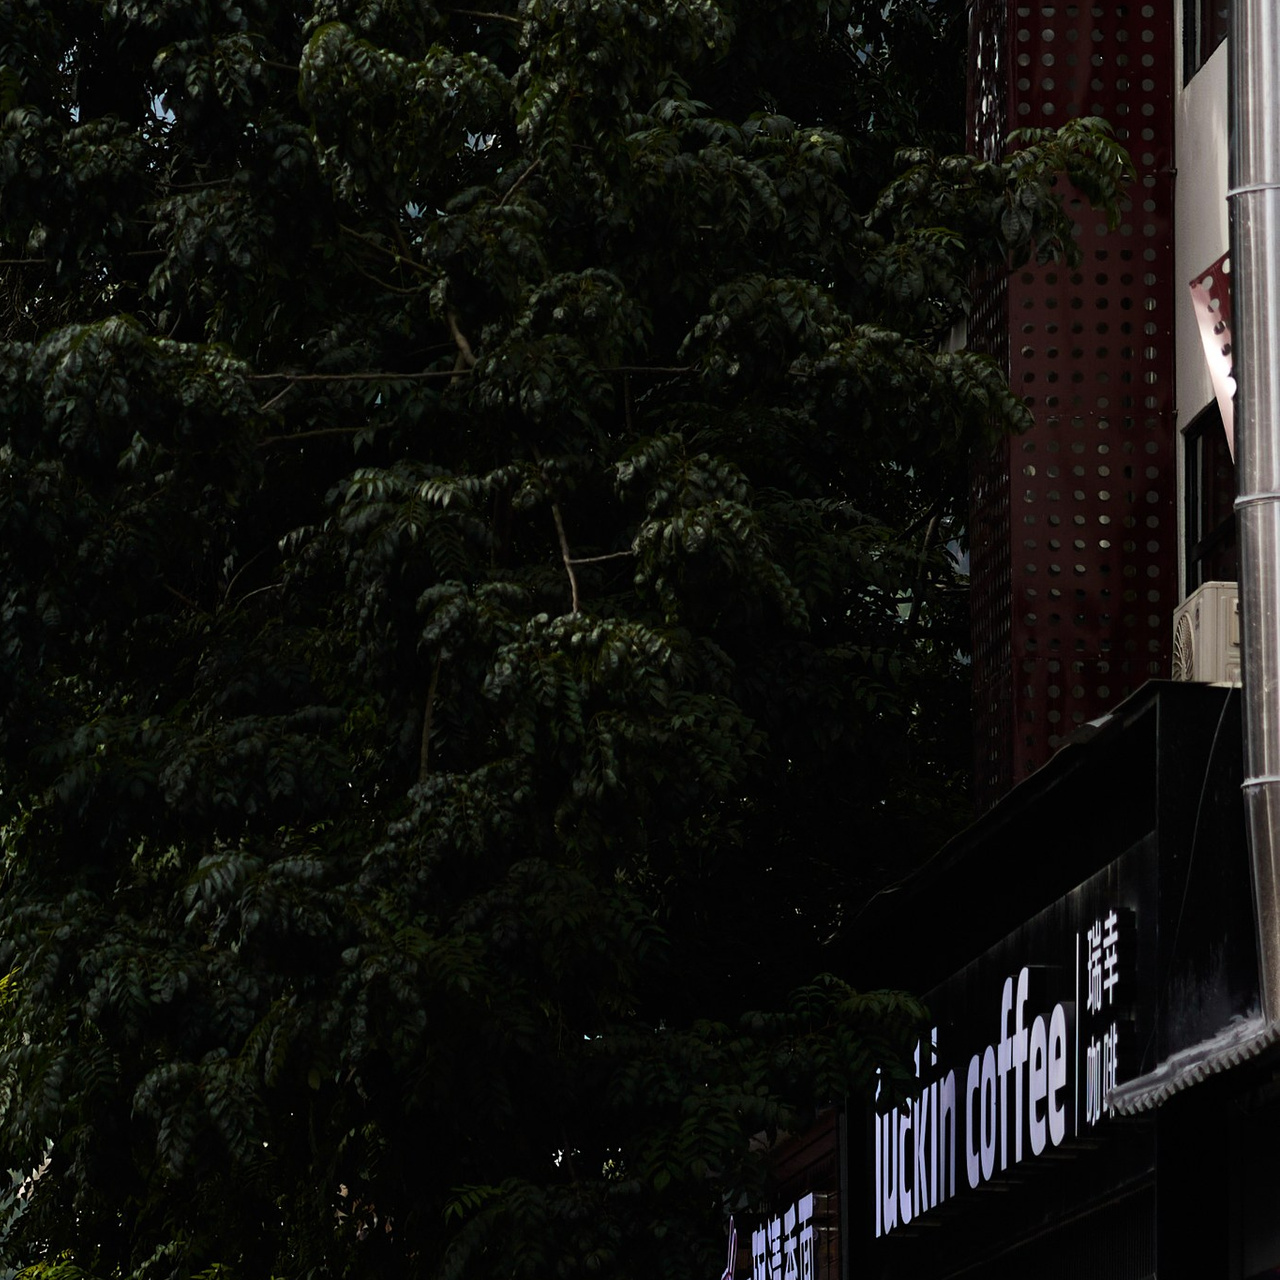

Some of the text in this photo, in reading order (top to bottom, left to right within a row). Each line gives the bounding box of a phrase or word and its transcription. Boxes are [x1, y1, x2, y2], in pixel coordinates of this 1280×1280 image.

[1087, 910, 1119, 1015] 瑞幸
[875, 966, 1067, 1238] luckin coffee
[1086, 1022, 1119, 1127] 咖啡
